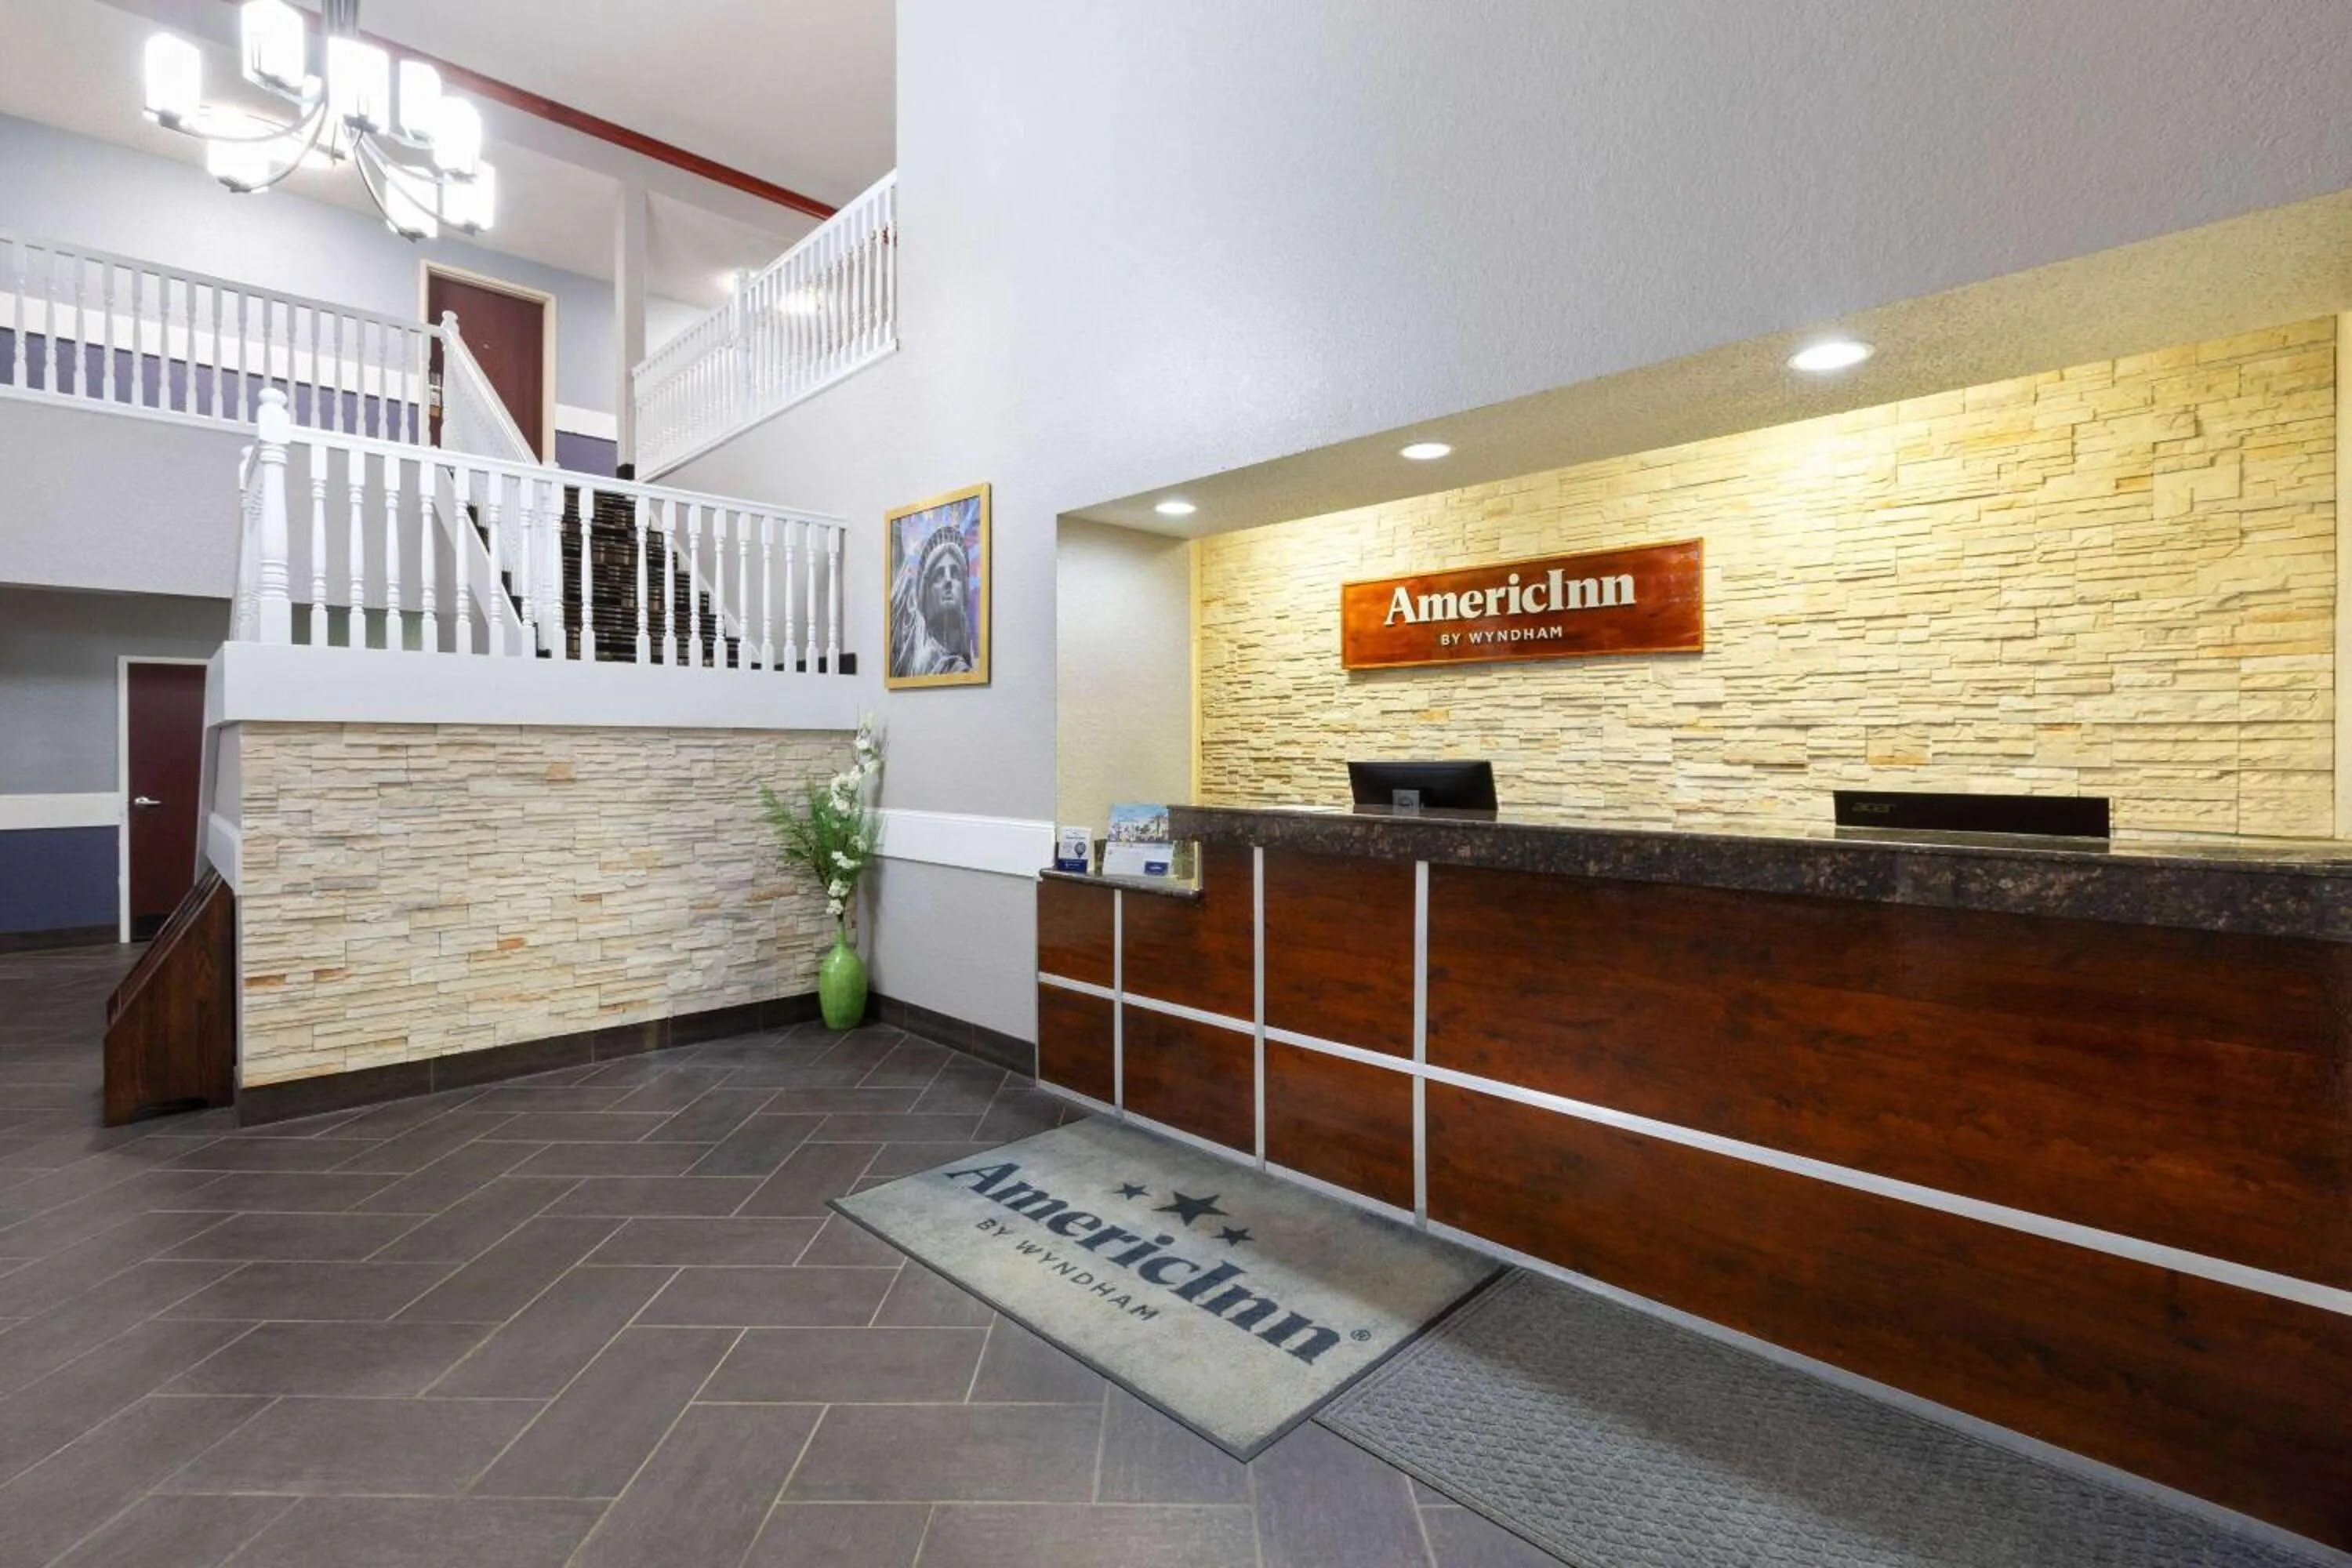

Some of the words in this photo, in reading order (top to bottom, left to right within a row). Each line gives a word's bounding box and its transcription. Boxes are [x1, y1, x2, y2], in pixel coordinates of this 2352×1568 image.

[1384, 568, 1635, 626] AmericInn
[1440, 633, 1461, 645] BY
[1468, 626, 1563, 644] WYNDHAM
[975, 1218, 1014, 1237] BY
[1015, 1240, 1160, 1320] WYNDHAM
